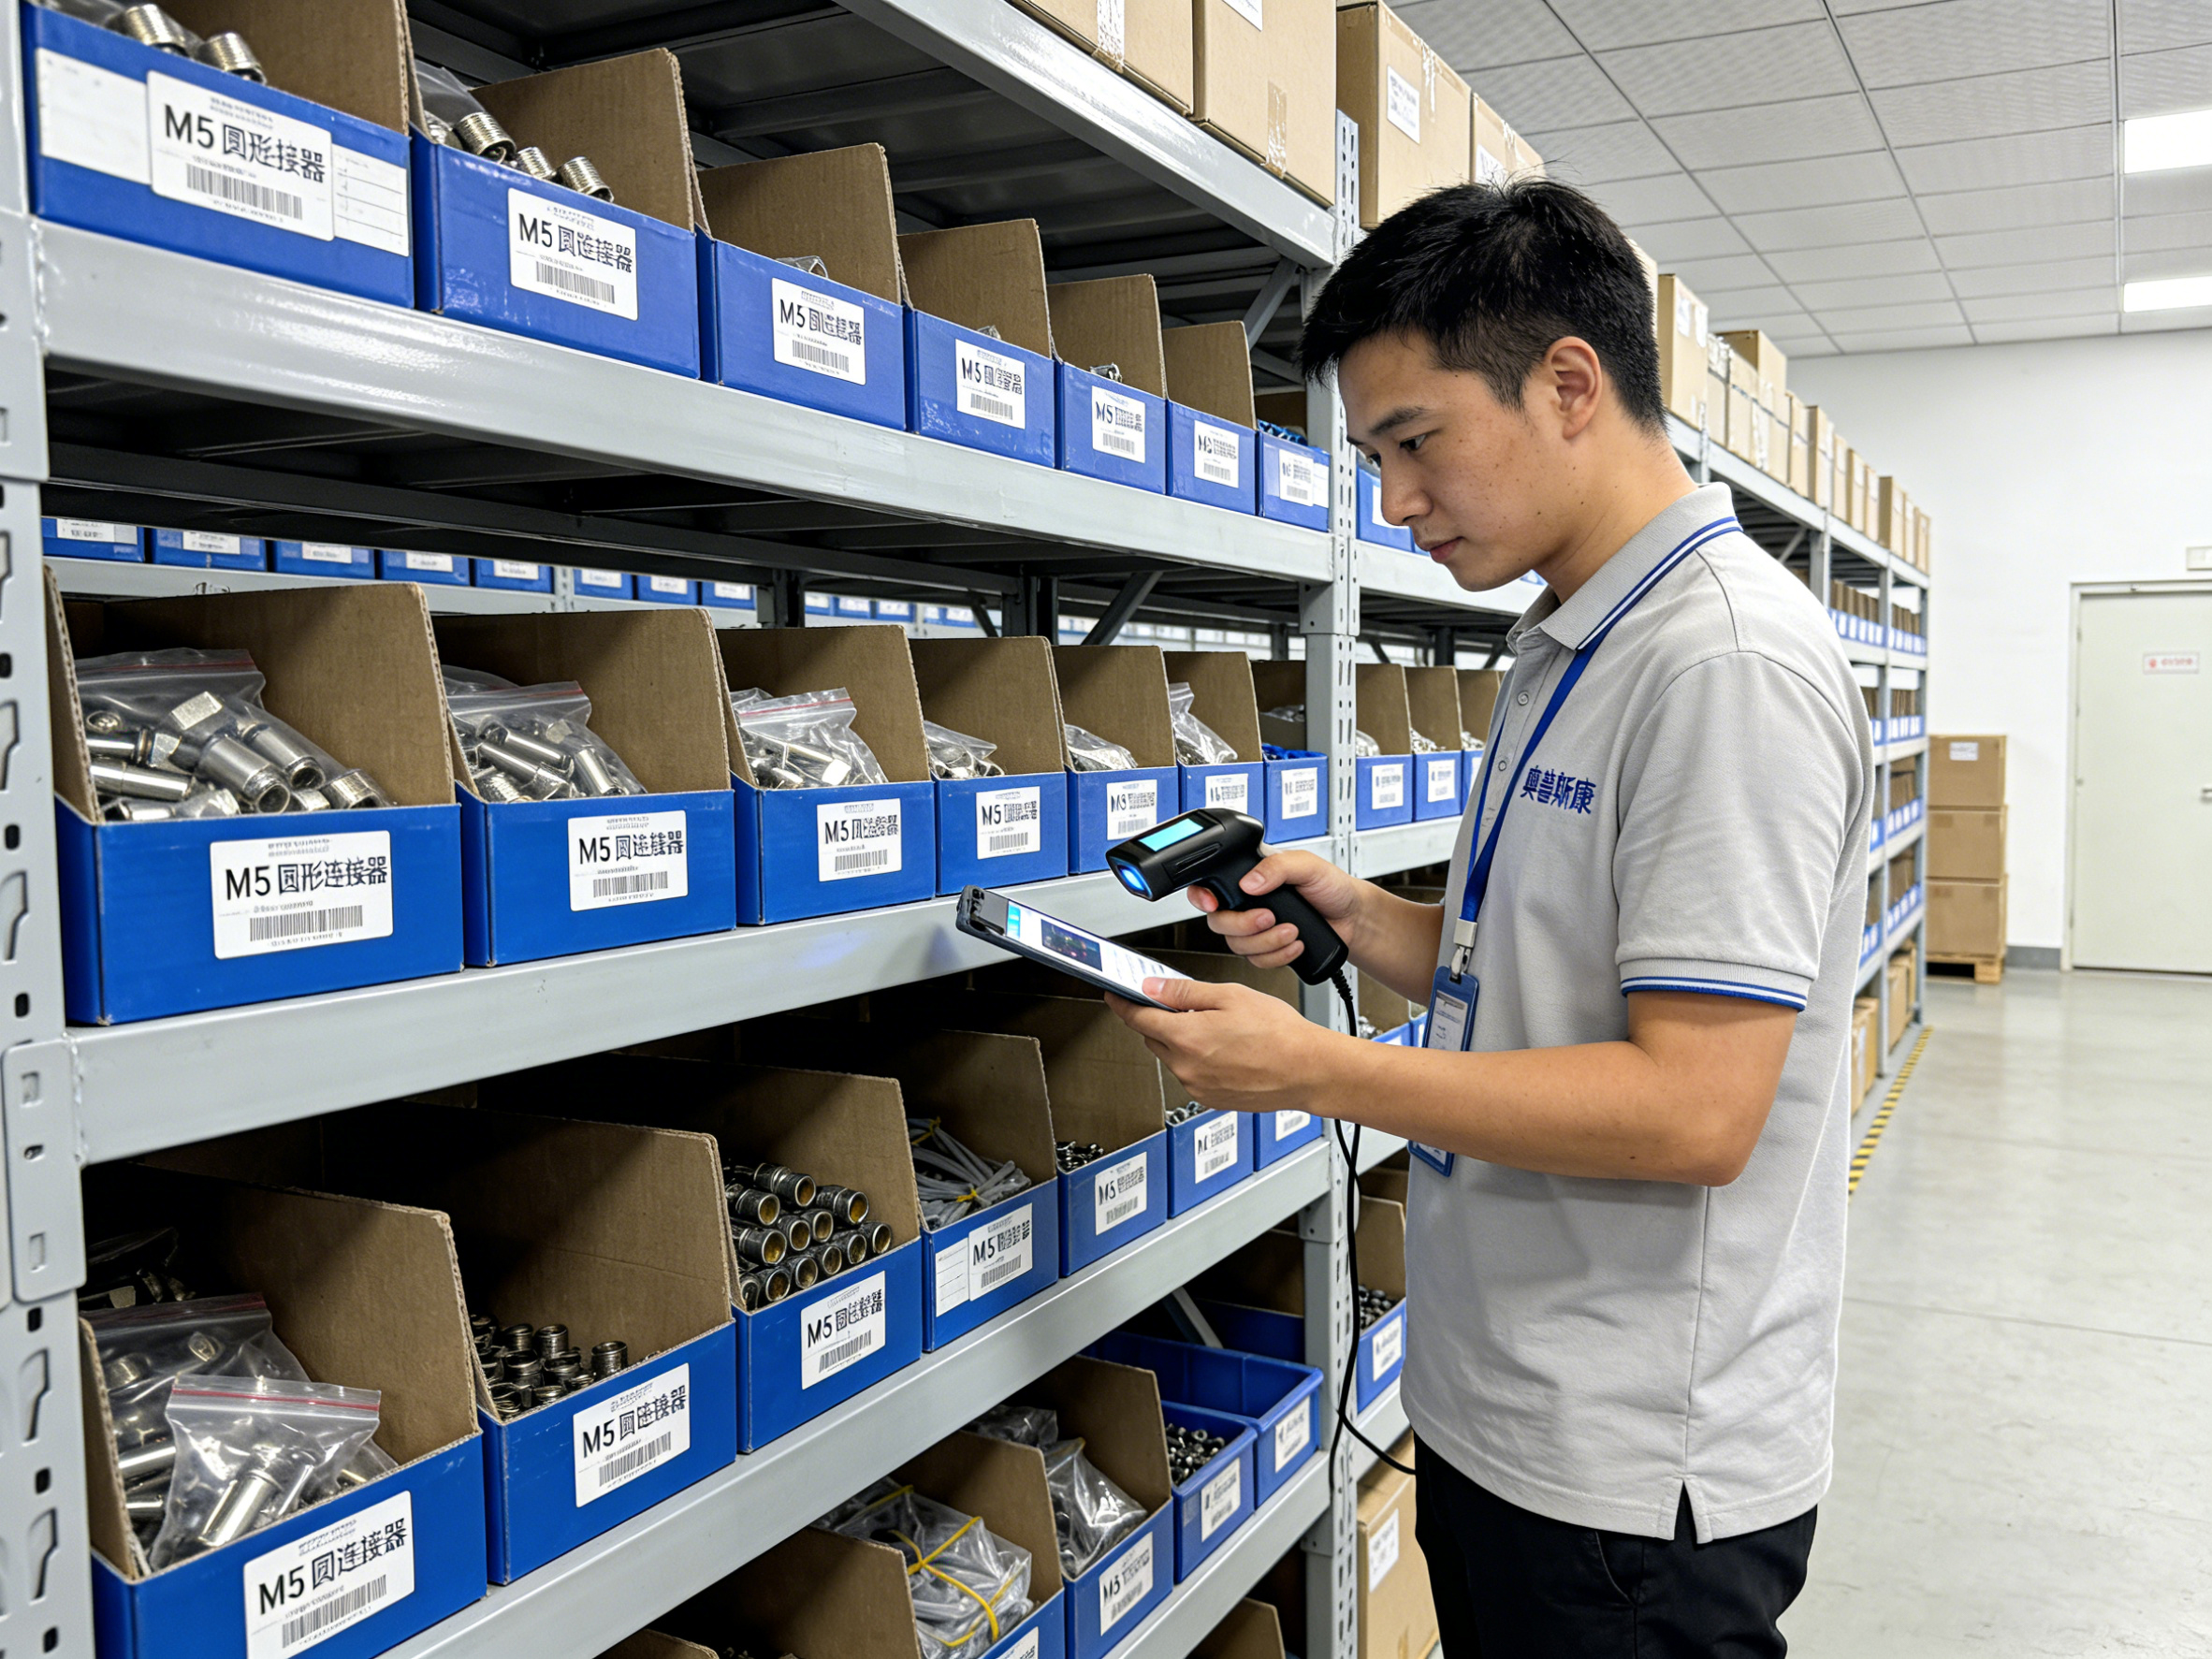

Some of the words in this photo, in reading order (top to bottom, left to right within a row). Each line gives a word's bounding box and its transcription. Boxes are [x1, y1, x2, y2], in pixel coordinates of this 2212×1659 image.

[165, 104, 214, 150] M5
[518, 213, 553, 248] M5
[780, 298, 806, 328] M5
[825, 820, 849, 844] M5
[579, 837, 611, 865] M5
[226, 866, 270, 901] M5
[973, 1236, 997, 1266] M5
[808, 1314, 833, 1348] M5
[583, 1419, 615, 1458] M5
[259, 1565, 305, 1615] M5
